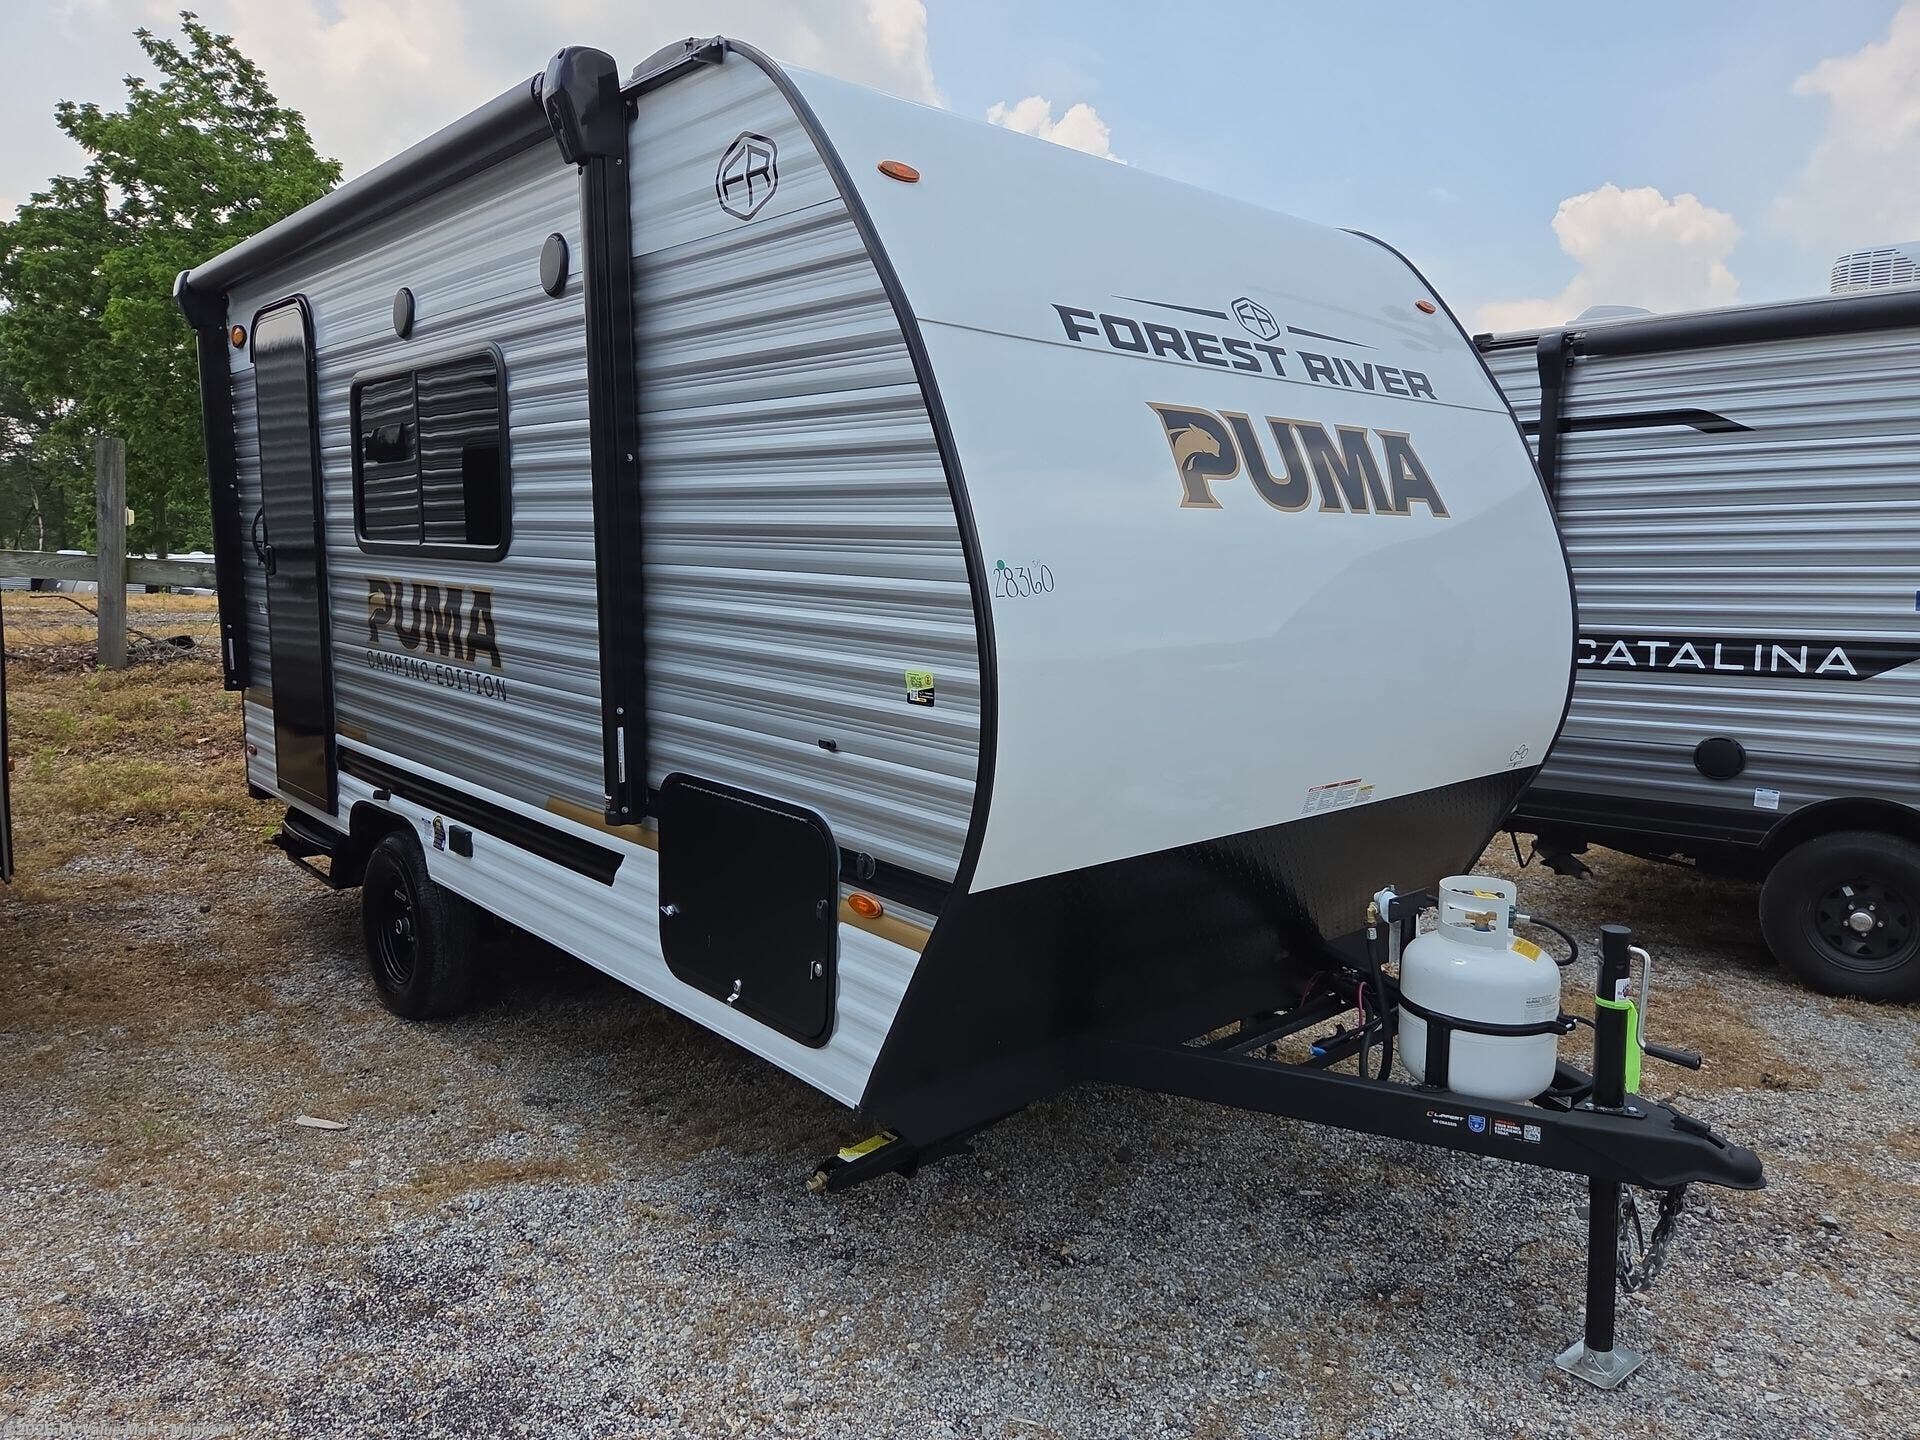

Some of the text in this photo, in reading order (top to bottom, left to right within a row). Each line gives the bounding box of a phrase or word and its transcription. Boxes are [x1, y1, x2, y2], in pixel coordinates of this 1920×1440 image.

[1050, 302, 1439, 400] FOREST RIVER
[1144, 401, 1451, 518] PUMA
[992, 564, 1055, 598] 28360
[366, 574, 503, 671] PUMA
[1578, 638, 1858, 676] CATALINA
[366, 650, 507, 701] CAMPING EDITION
